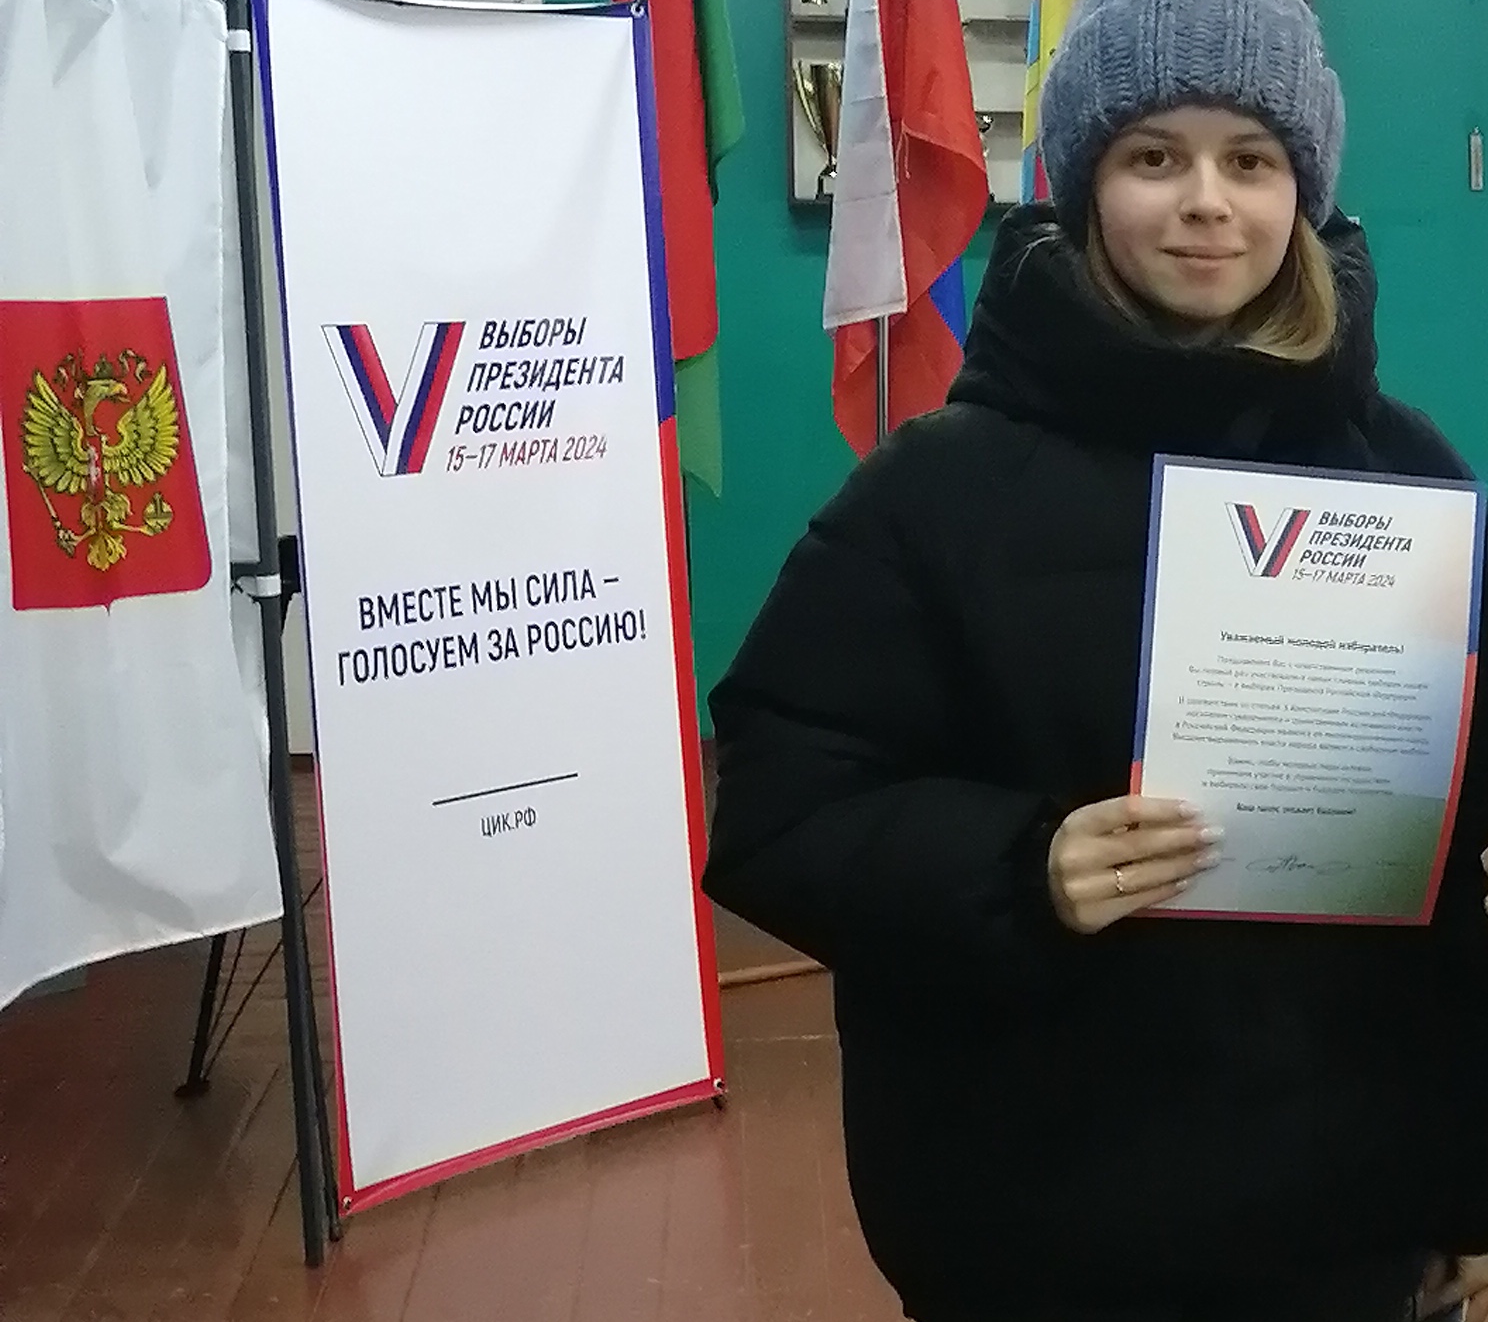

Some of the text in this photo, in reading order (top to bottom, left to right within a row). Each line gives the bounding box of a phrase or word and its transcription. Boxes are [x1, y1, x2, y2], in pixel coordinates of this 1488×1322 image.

[479, 317, 587, 350] ВЫБОРЫ
[467, 356, 625, 392] ПРЕЗИДЕНТА
[455, 399, 556, 434] РОССИИ
[499, 438, 559, 467] МАРТА
[562, 434, 608, 462] 2024
[1318, 511, 1393, 531] ВЫБОРЫ
[1309, 530, 1413, 552] ПРЕЗИДЕНТА
[1299, 549, 1368, 568] РОССИИ
[1326, 570, 1366, 585] МАРТА
[1367, 574, 1396, 588] 2024
[358, 584, 464, 631] ВМЕСТЕ
[471, 578, 518, 614] МЫ
[526, 569, 597, 607] СИЛА
[337, 609, 647, 686] ГОЛОСУЕМ ЗА РОССИЮ!
[481, 806, 536, 837] ЦИК.РФ
